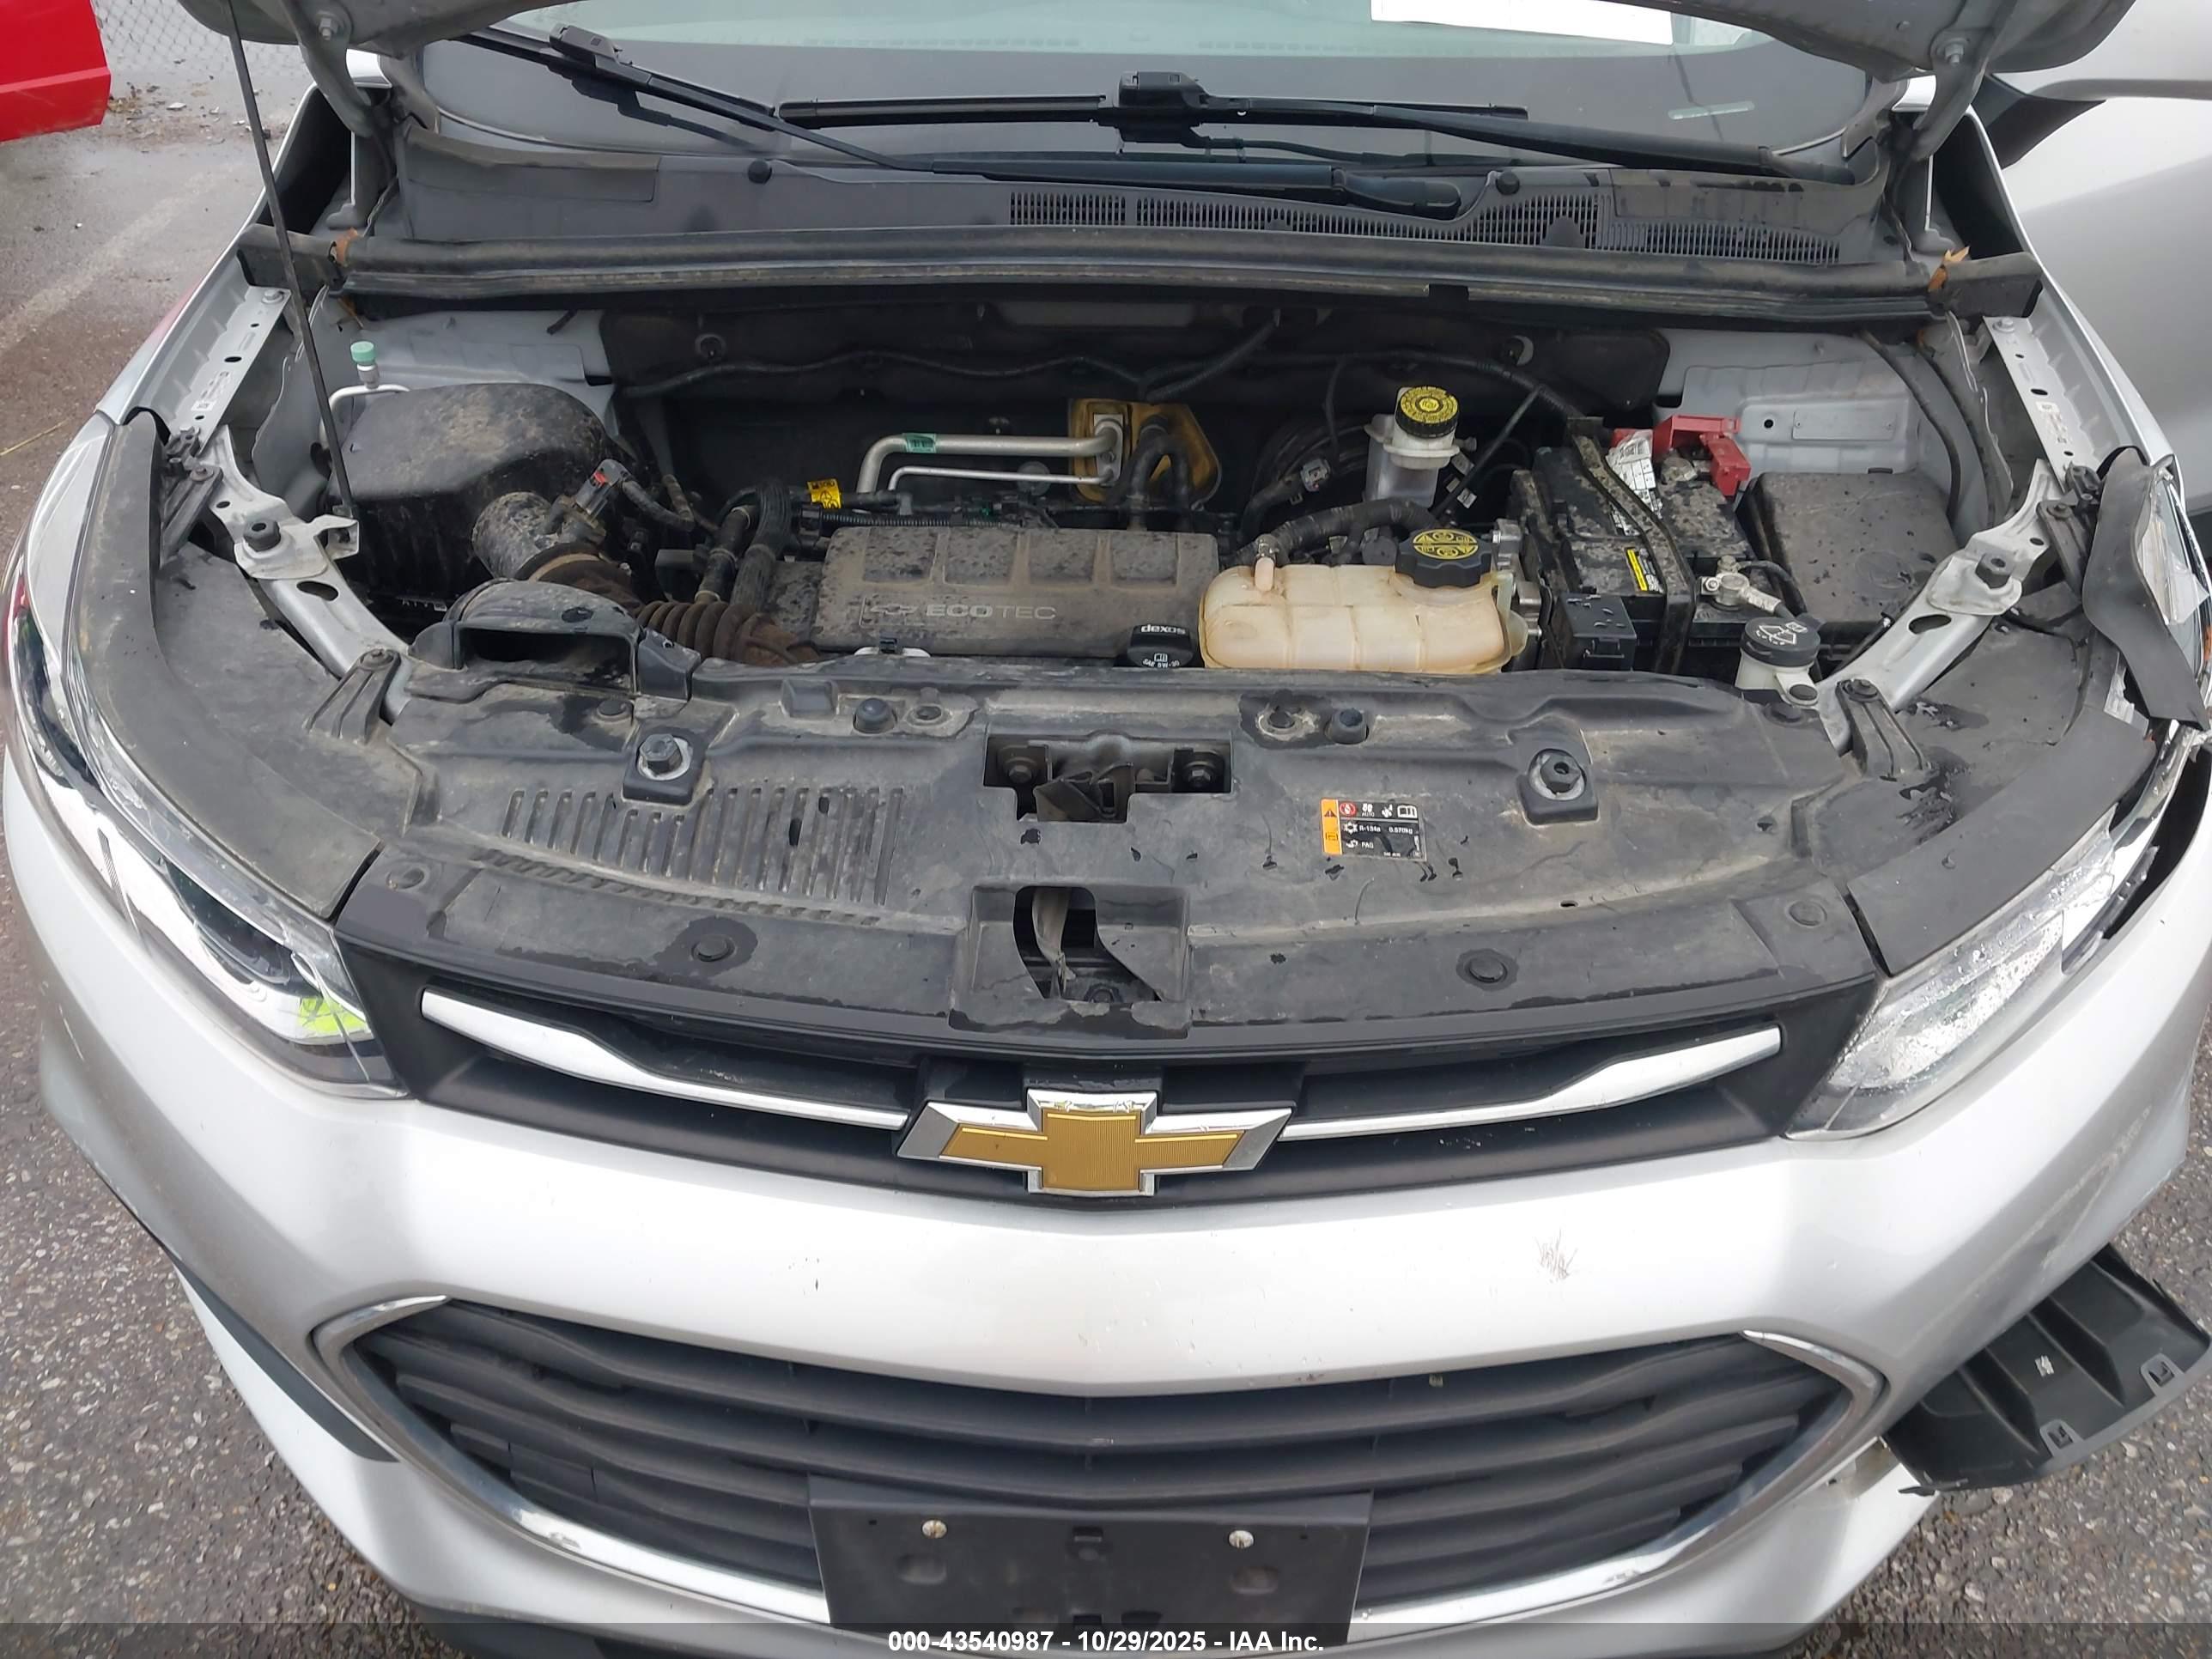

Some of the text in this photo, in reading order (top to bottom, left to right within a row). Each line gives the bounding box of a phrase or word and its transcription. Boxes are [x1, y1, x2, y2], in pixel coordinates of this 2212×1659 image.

[926, 603, 1057, 620] ECOTEC
[1140, 623, 1186, 635] dexos
[1359, 824, 1381, 833] R-134a
